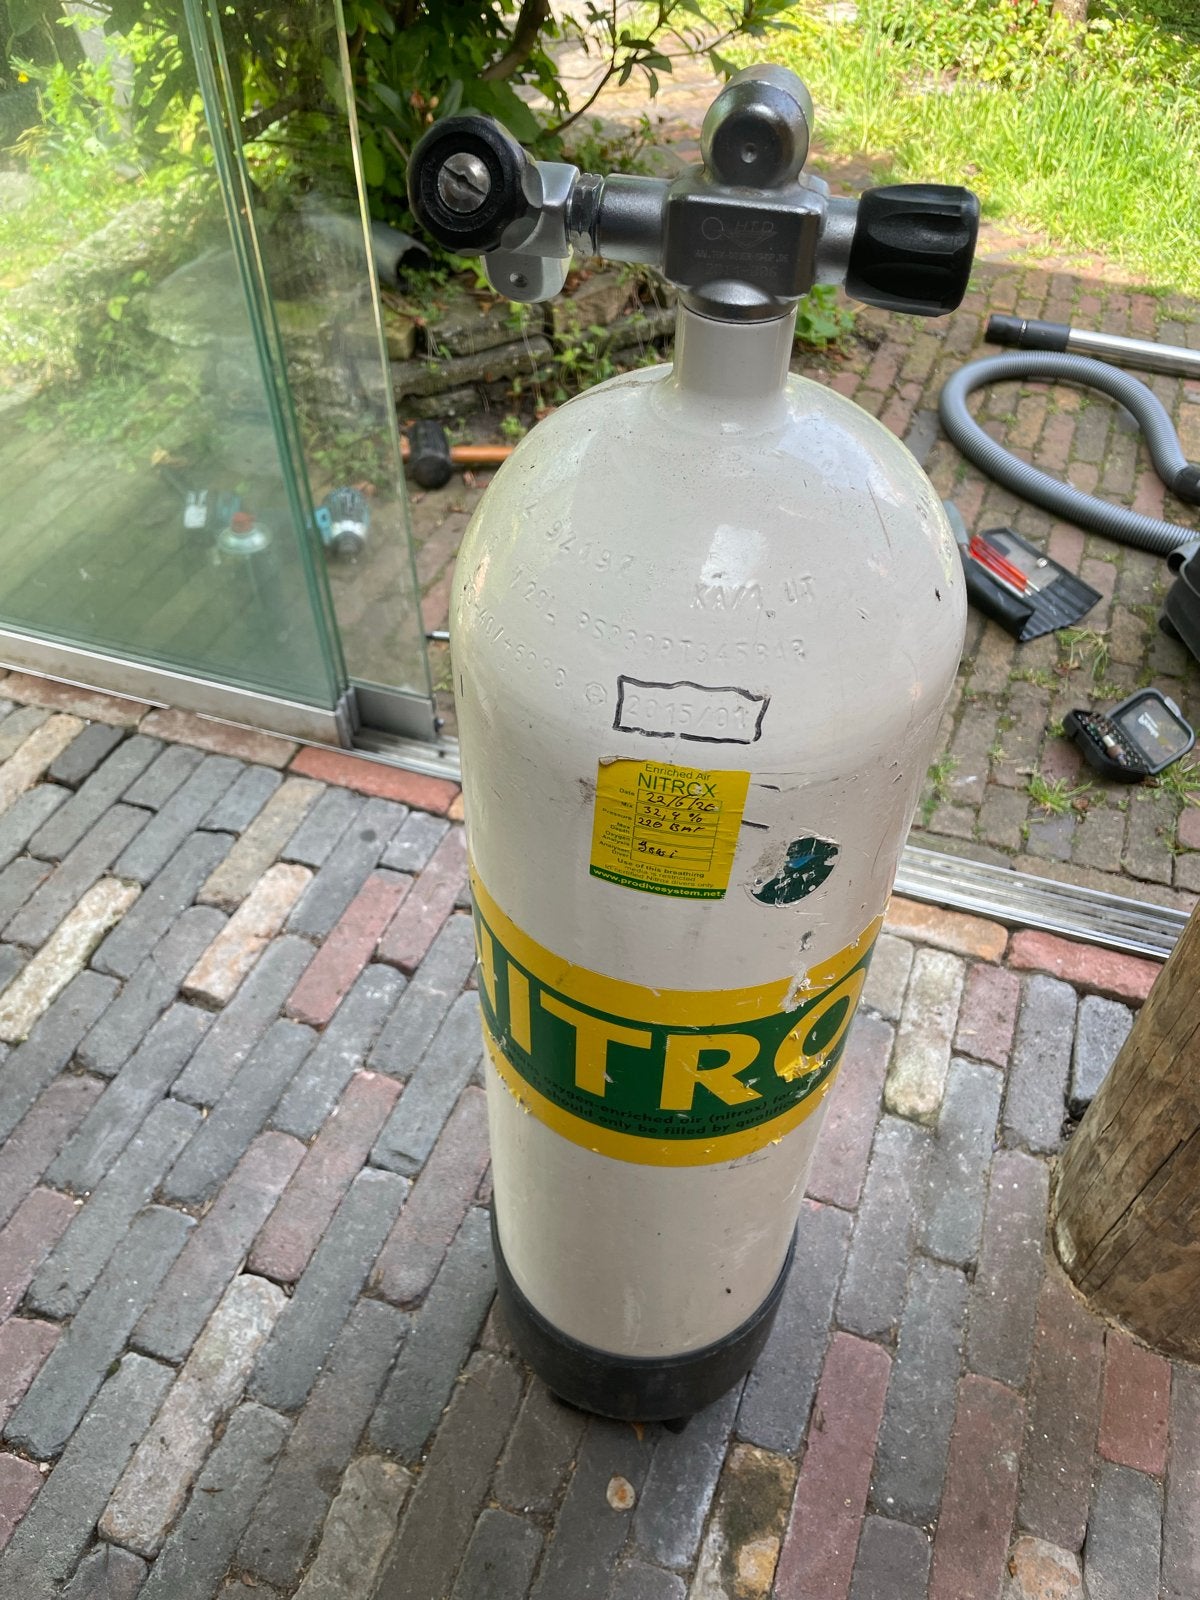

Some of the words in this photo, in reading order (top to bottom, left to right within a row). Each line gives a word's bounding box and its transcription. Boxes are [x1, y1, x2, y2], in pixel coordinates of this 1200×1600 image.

[646, 763, 693, 778] Enriched
[617, 858, 632, 866] Use
[646, 865, 661, 873] this
[664, 868, 704, 878] breathing
[593, 868, 721, 898] www.prodivesystem.net
[680, 1115, 703, 1124] air
[708, 1102, 767, 1123] (nitrox)
[598, 1115, 632, 1130] only
[638, 1124, 658, 1134] be
[664, 1126, 706, 1135] filled
[711, 1124, 730, 1133] by
